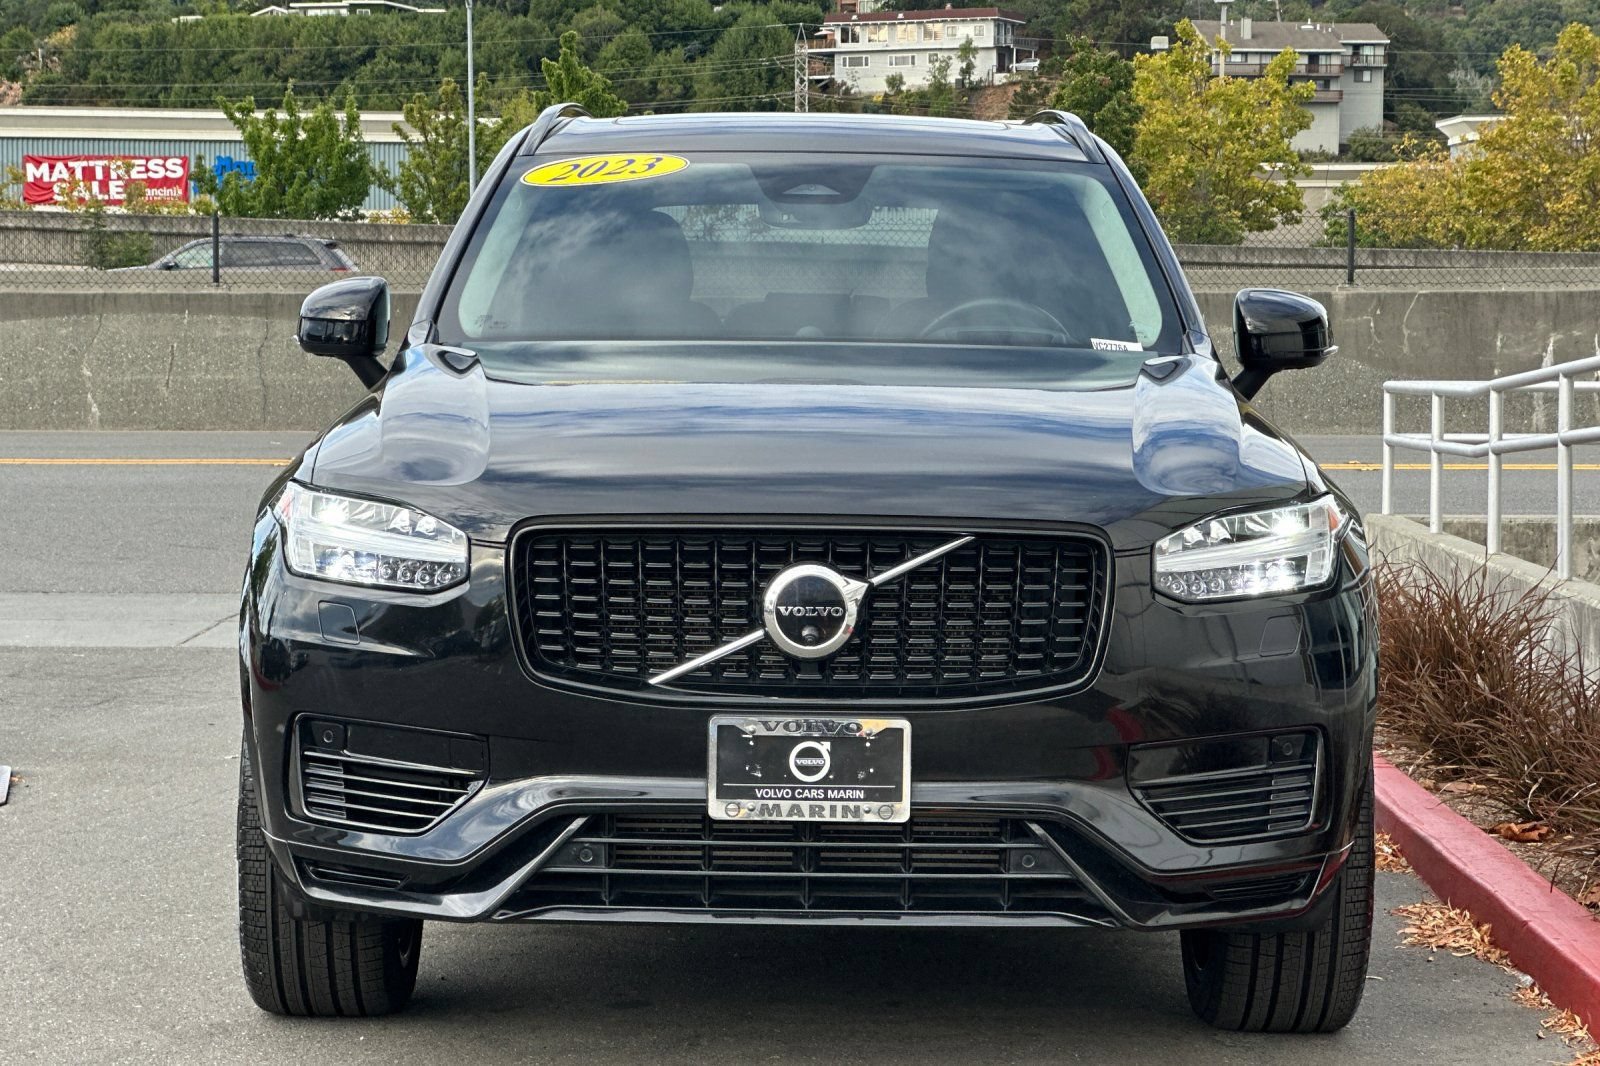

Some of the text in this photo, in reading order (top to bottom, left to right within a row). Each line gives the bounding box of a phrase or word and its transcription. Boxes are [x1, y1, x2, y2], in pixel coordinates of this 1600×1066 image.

[546, 156, 663, 183] 2023
[777, 606, 844, 617] VOLVO
[758, 719, 863, 734] VOLVO
[755, 788, 864, 800] VOLVO CARS MARIN
[757, 803, 862, 819] MARIN
